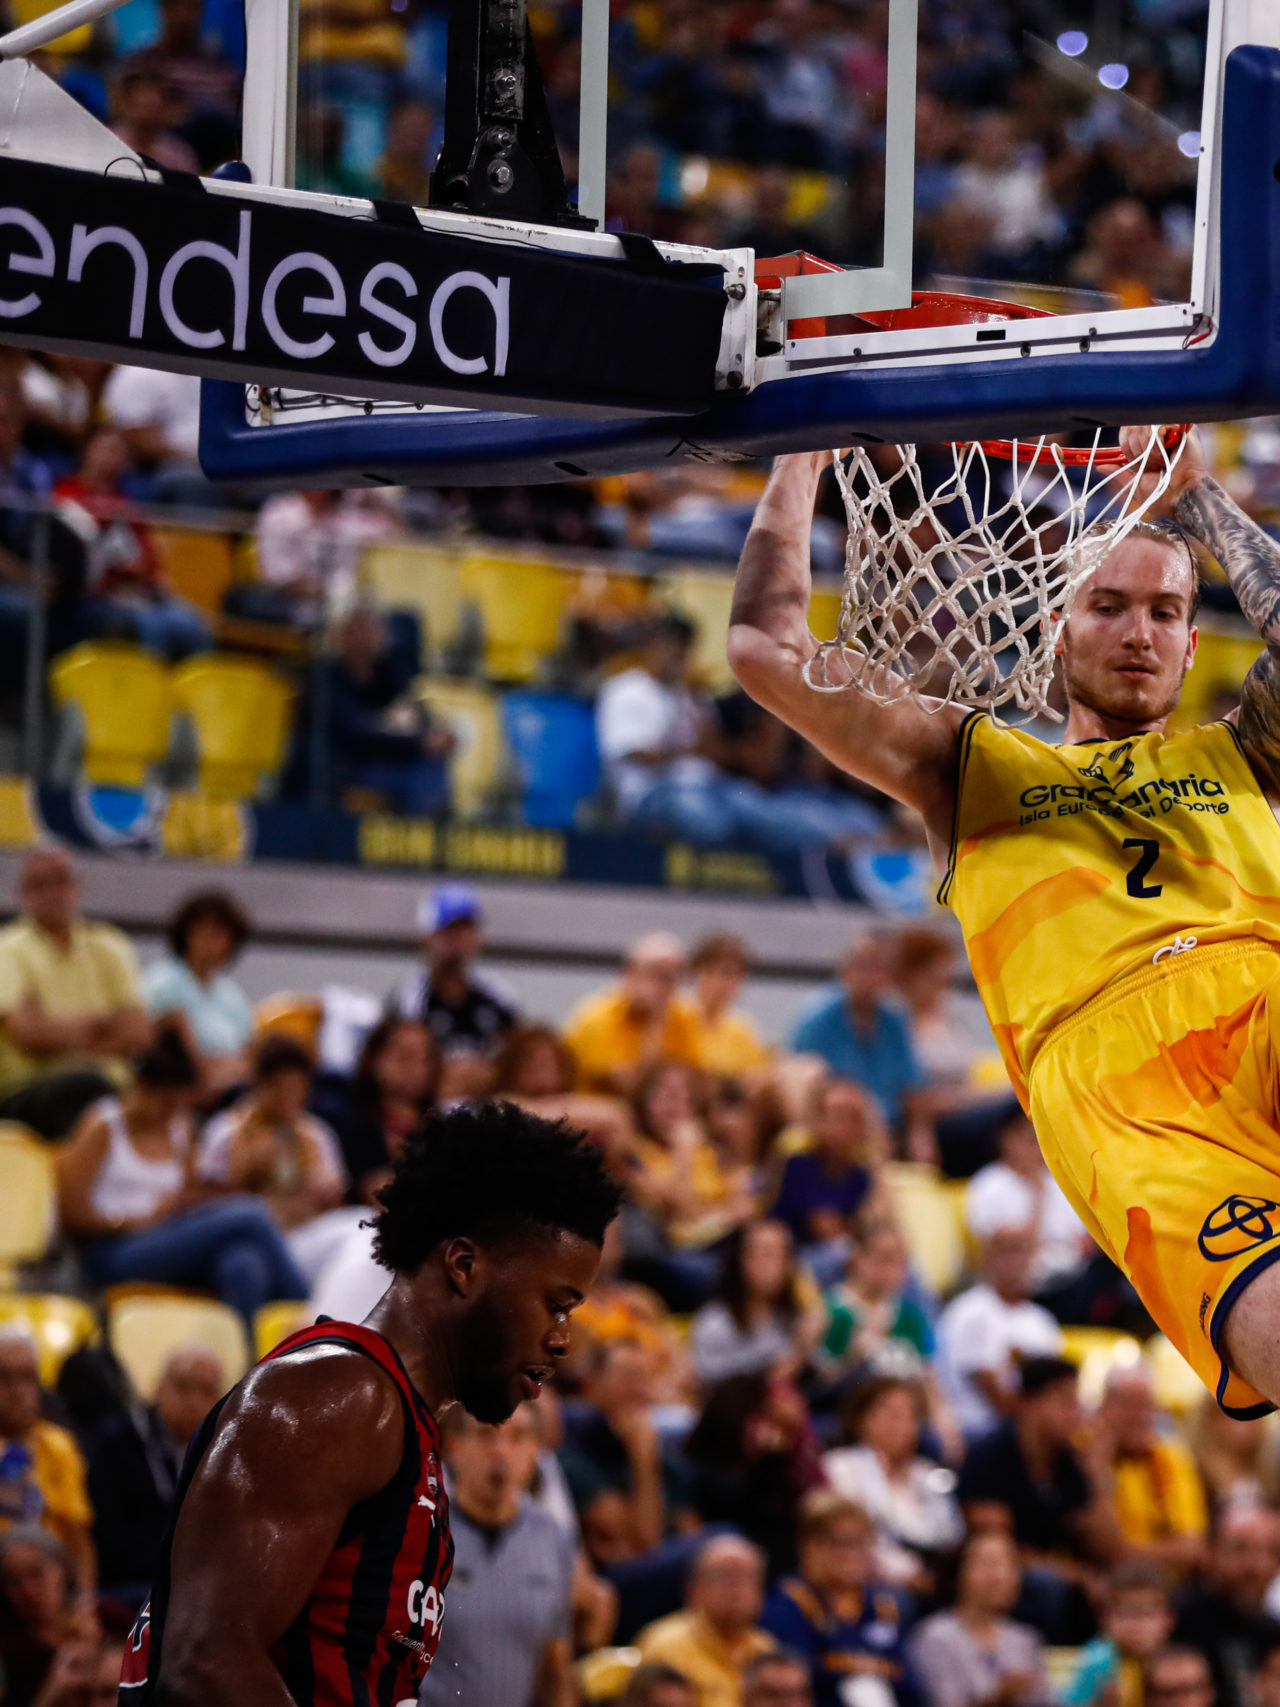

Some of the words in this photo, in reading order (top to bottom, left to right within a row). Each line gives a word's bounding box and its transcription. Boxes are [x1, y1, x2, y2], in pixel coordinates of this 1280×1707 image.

[0, 207, 511, 377] endesa
[1020, 810, 1051, 827] Isla
[1122, 838, 1163, 899] 2
